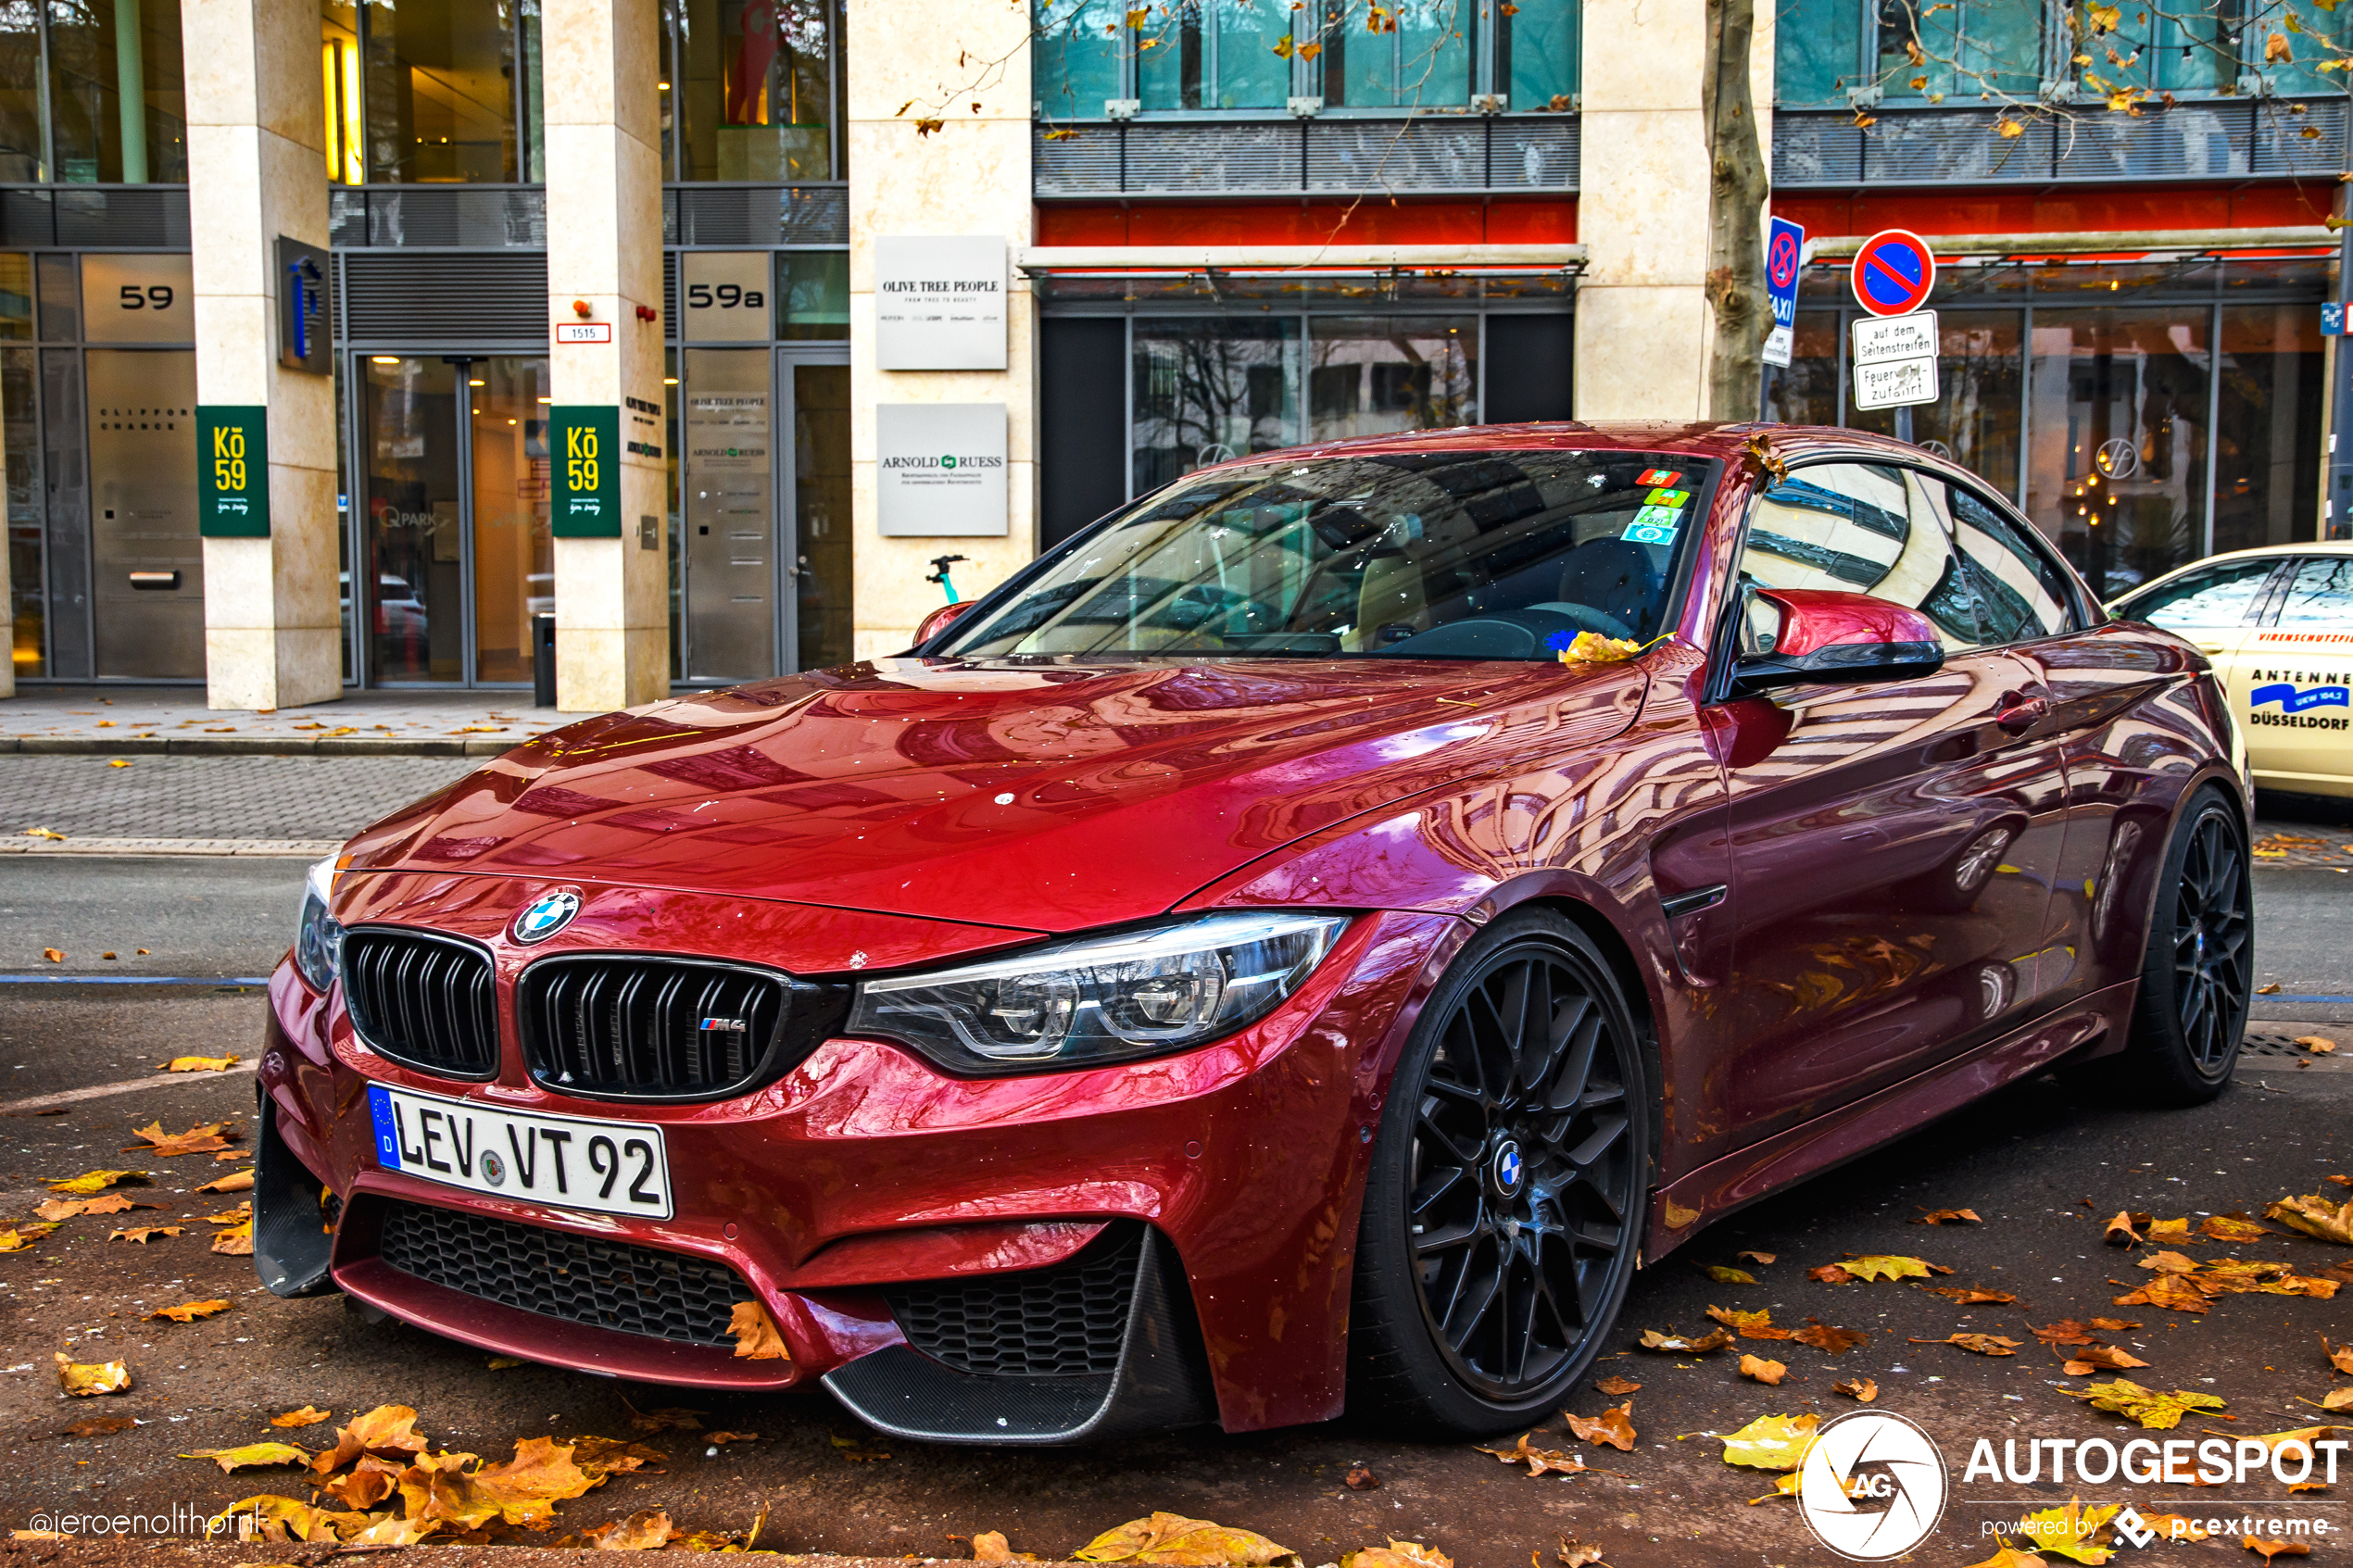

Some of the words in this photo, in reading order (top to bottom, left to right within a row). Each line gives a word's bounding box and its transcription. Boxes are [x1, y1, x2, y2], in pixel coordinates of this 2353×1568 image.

[883, 281, 917, 293] OLIVE
[920, 281, 950, 293] TREE
[953, 281, 999, 293] PEOPLE
[120, 285, 174, 309] 59
[688, 283, 764, 308] 59a
[1768, 294, 1793, 321] AXI
[573, 328, 596, 339] 1515
[1873, 329, 1889, 340] auf
[1894, 324, 1916, 337] dem
[1861, 338, 1931, 358] Seitenstreifen
[100, 408, 197, 417] CLIFFOR
[882, 457, 939, 469] ARNOLD
[959, 456, 1002, 468] RUESS
[214, 458, 246, 491] 59
[568, 458, 599, 491] 59
[1646, 476, 1666, 485] 20
[1655, 495, 1674, 506] 21
[2251, 669, 2351, 685] ANTENNE
[2294, 693, 2318, 707] UKW
[2319, 691, 2343, 700] 104.2
[2250, 710, 2350, 731] DÜSSELDORF
[713, 1018, 747, 1033] M4
[384, 1135, 393, 1153] D
[394, 1100, 473, 1179] LEV
[507, 1122, 573, 1194] VT
[588, 1134, 661, 1205] 92
